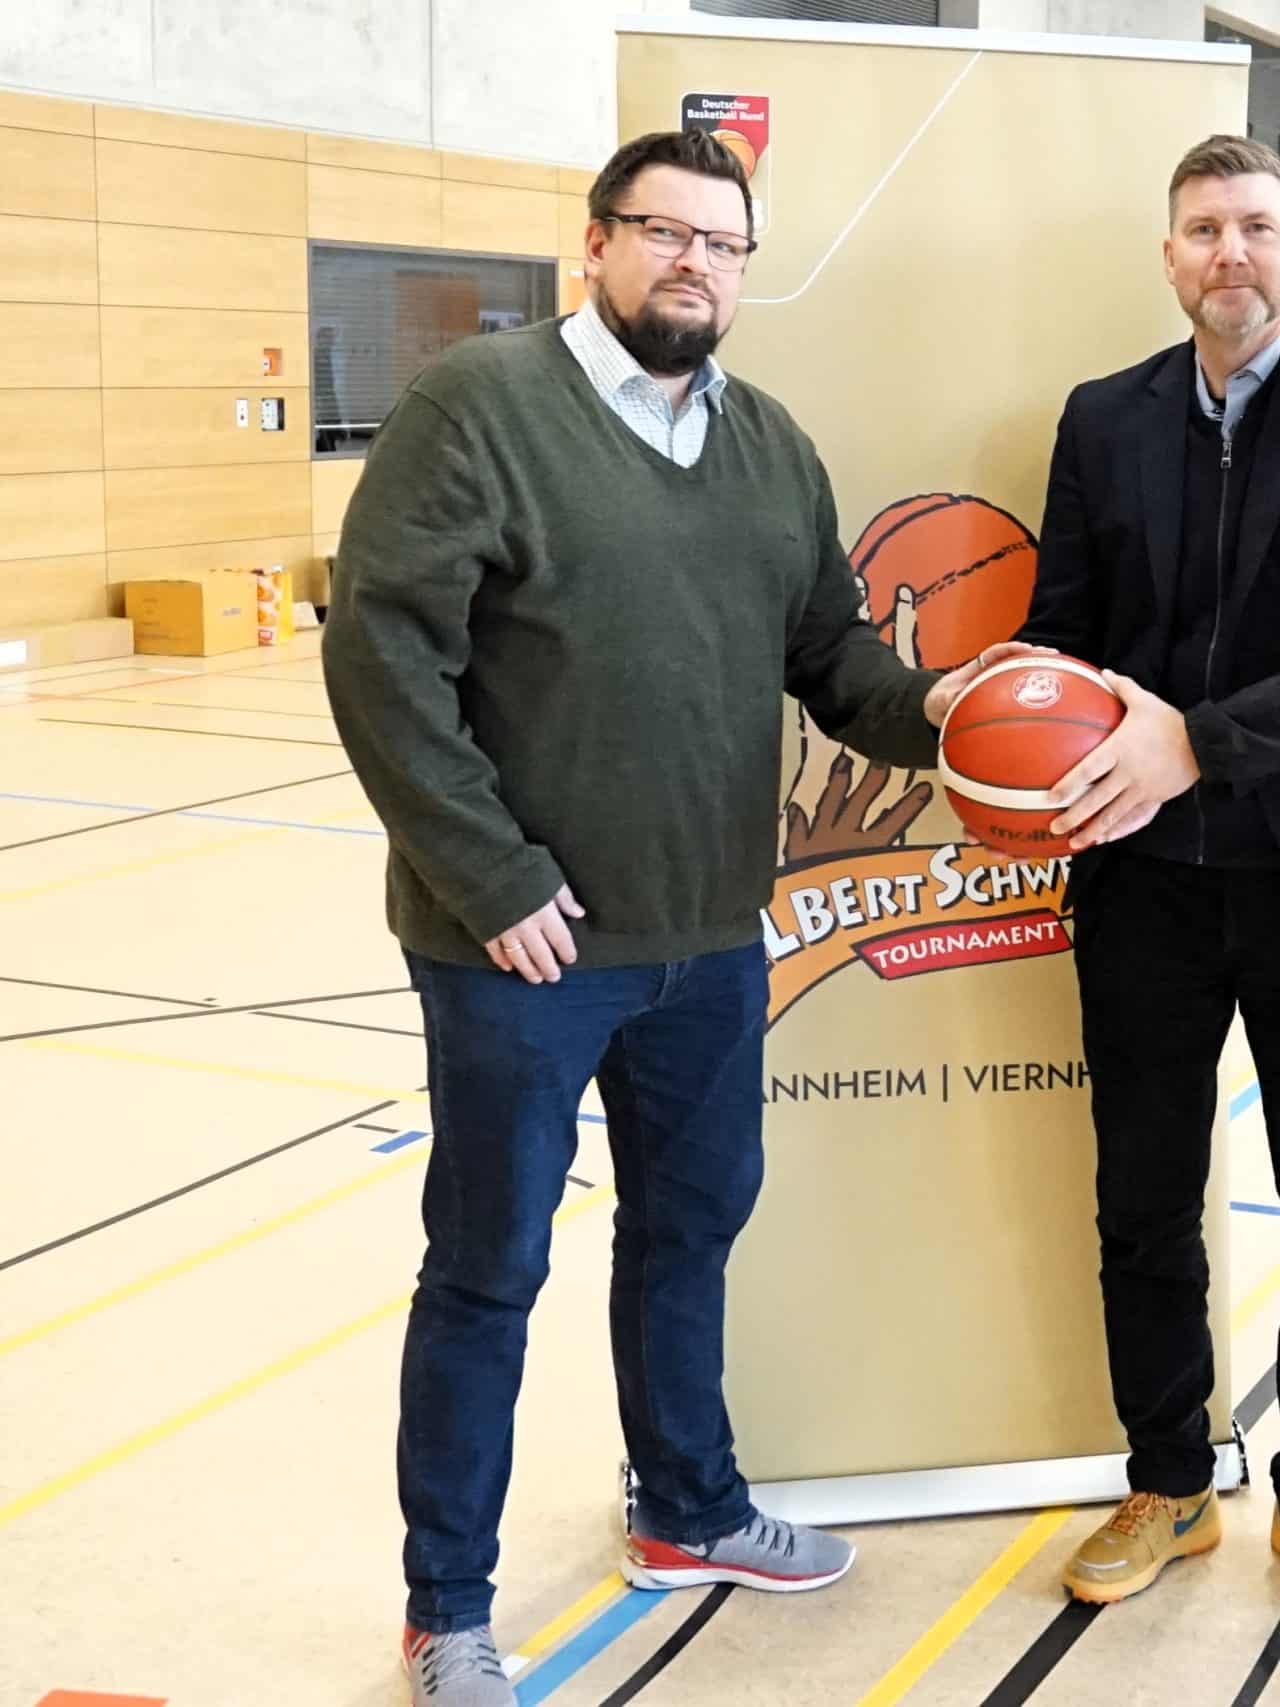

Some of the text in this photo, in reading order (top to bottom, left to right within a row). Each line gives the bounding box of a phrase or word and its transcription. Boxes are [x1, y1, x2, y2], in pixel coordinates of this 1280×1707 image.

[687, 108, 738, 121] Basketball
[702, 98, 750, 110] Deutscher
[760, 873, 926, 961] LBERT
[872, 921, 1060, 969] TOURNAMENT
[763, 1067, 927, 1103] NNHEIM
